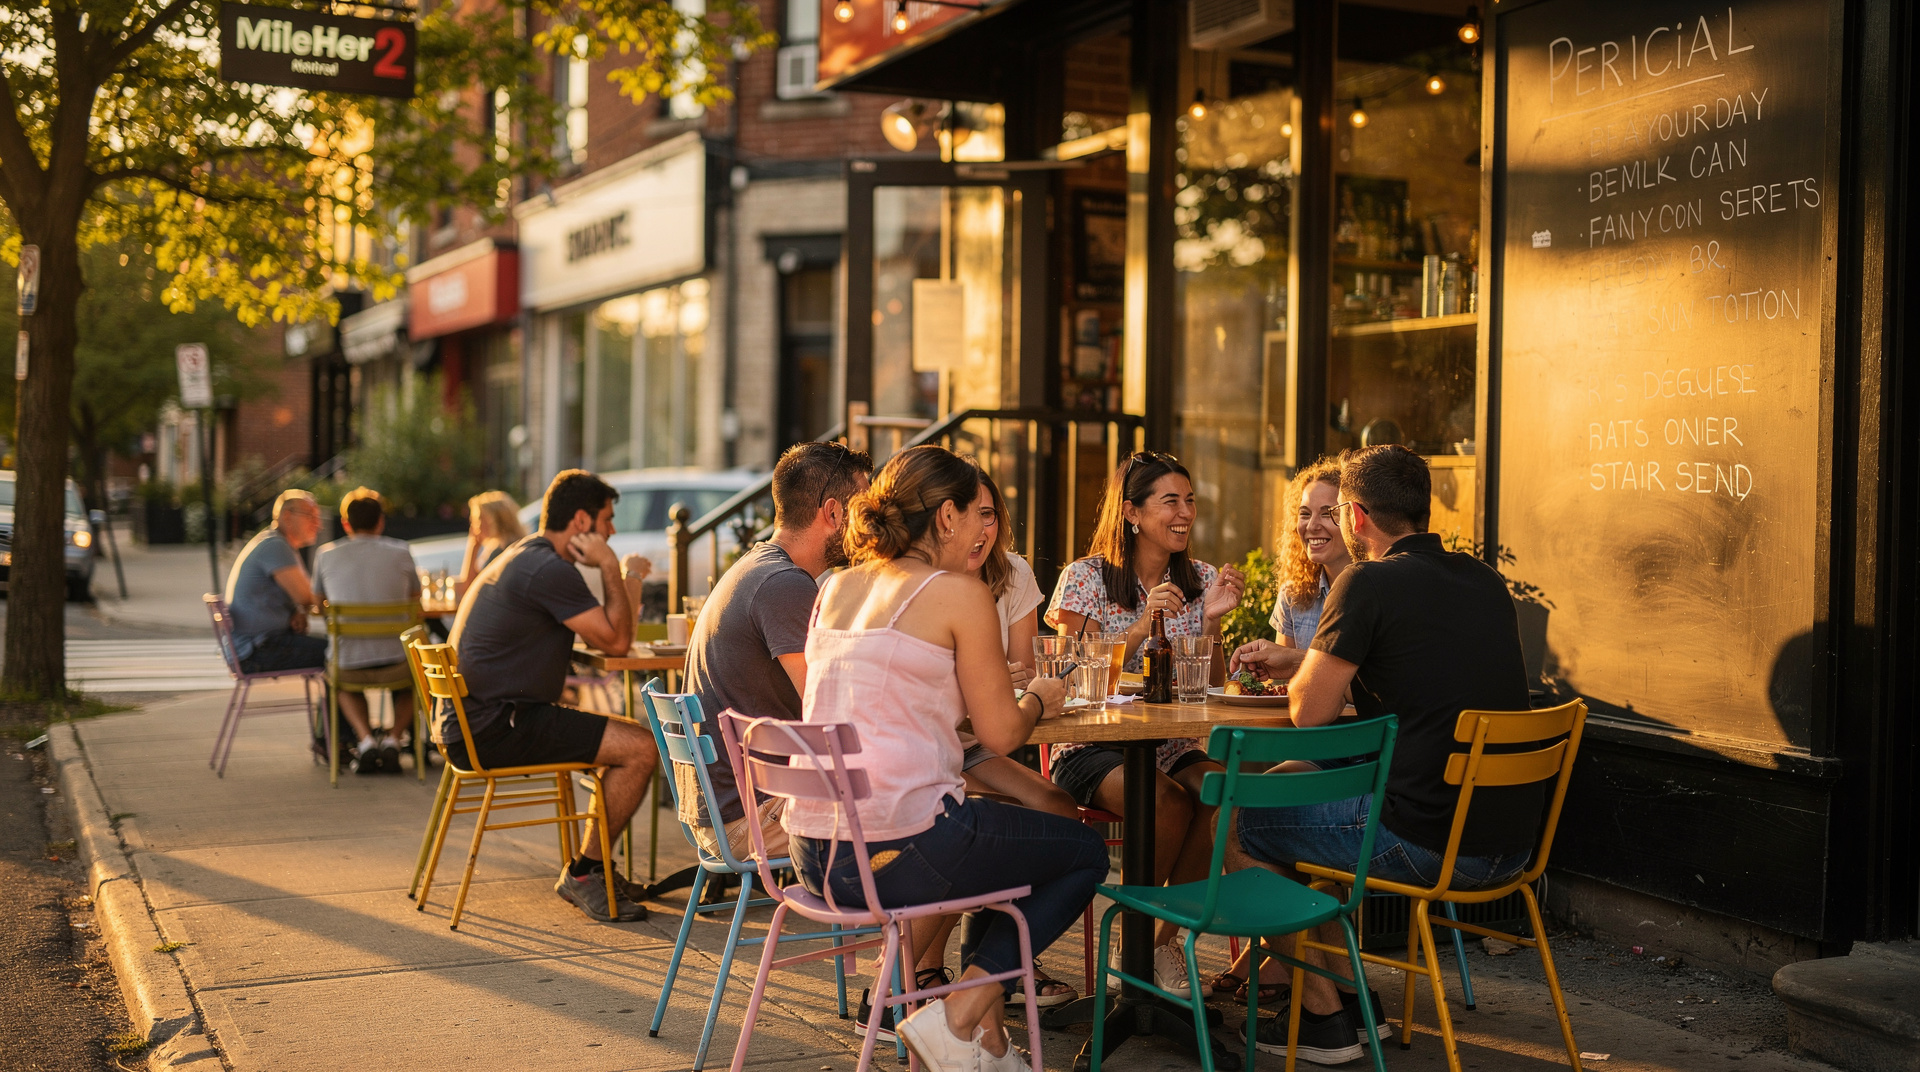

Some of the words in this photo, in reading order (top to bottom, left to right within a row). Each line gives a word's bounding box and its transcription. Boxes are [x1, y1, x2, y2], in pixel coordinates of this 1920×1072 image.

[1689, 138, 1748, 179] CAN
[1719, 177, 1821, 221] SERETS
[1675, 461, 1753, 502] SEND
